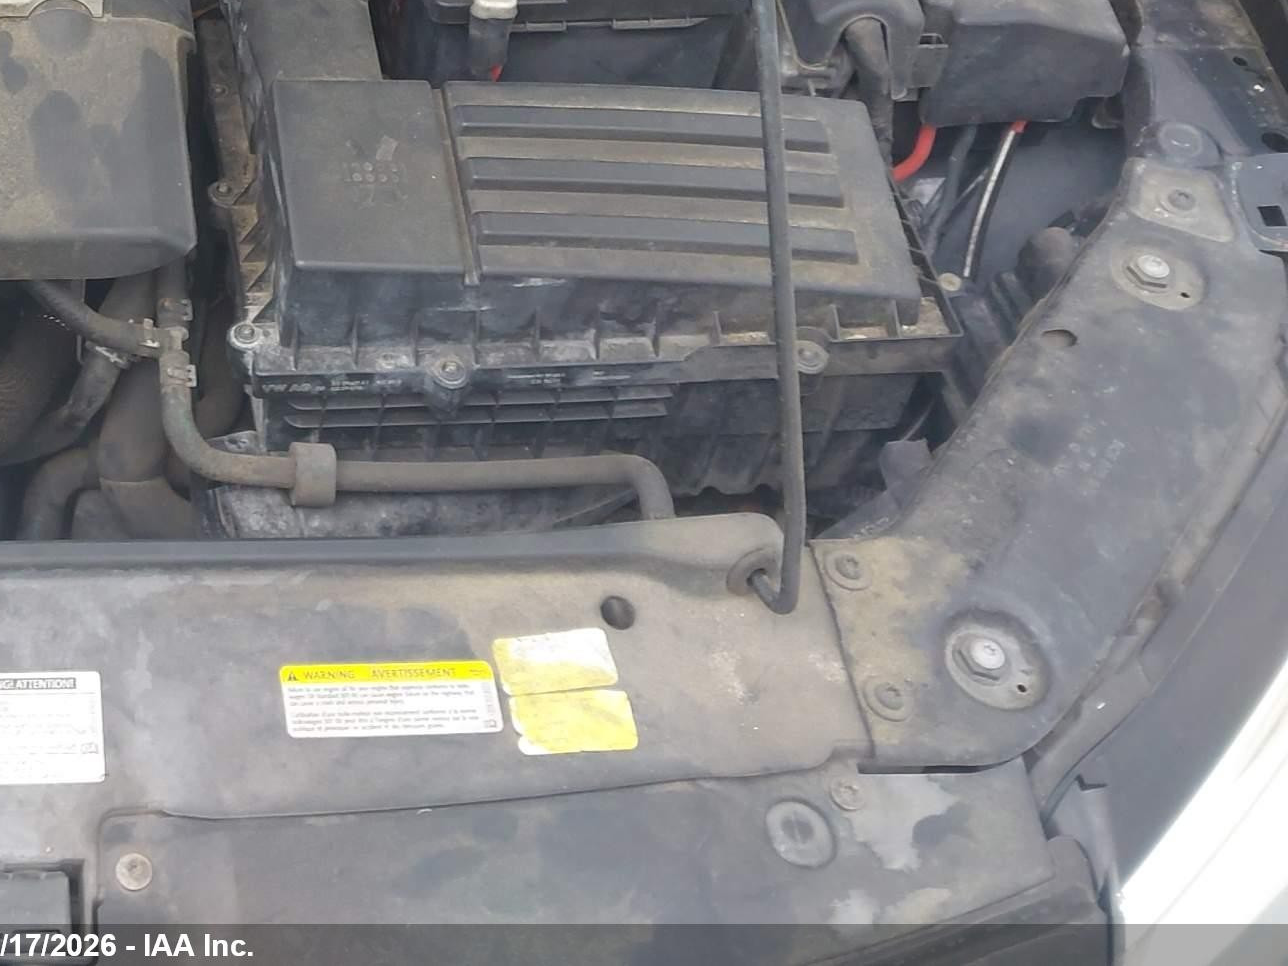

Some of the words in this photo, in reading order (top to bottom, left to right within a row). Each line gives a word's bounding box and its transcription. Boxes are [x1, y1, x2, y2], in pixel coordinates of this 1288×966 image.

[303, 670, 355, 680] WARNING
[371, 667, 457, 679] AVERTISSEMENT
[15, 677, 75, 690] ATTENTION!
